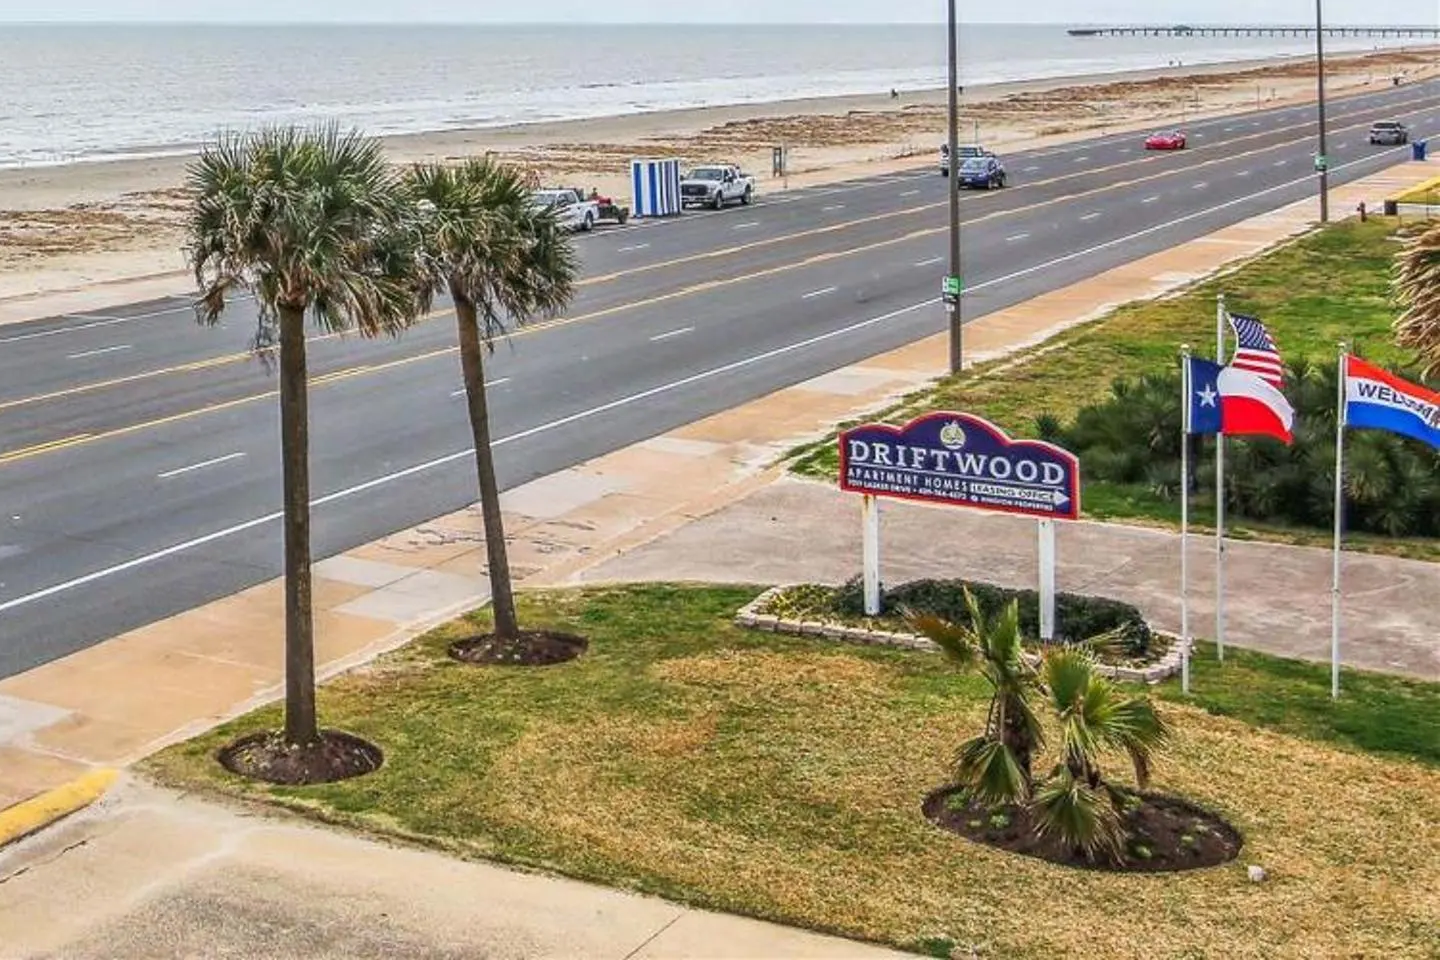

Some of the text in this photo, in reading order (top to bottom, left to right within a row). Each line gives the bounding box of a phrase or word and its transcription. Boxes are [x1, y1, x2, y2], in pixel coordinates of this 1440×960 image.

[848, 440, 1065, 485] DRIFTWOOD
[847, 467, 967, 493] APARTMENT HOMES
[972, 483, 1016, 497] LEASING
